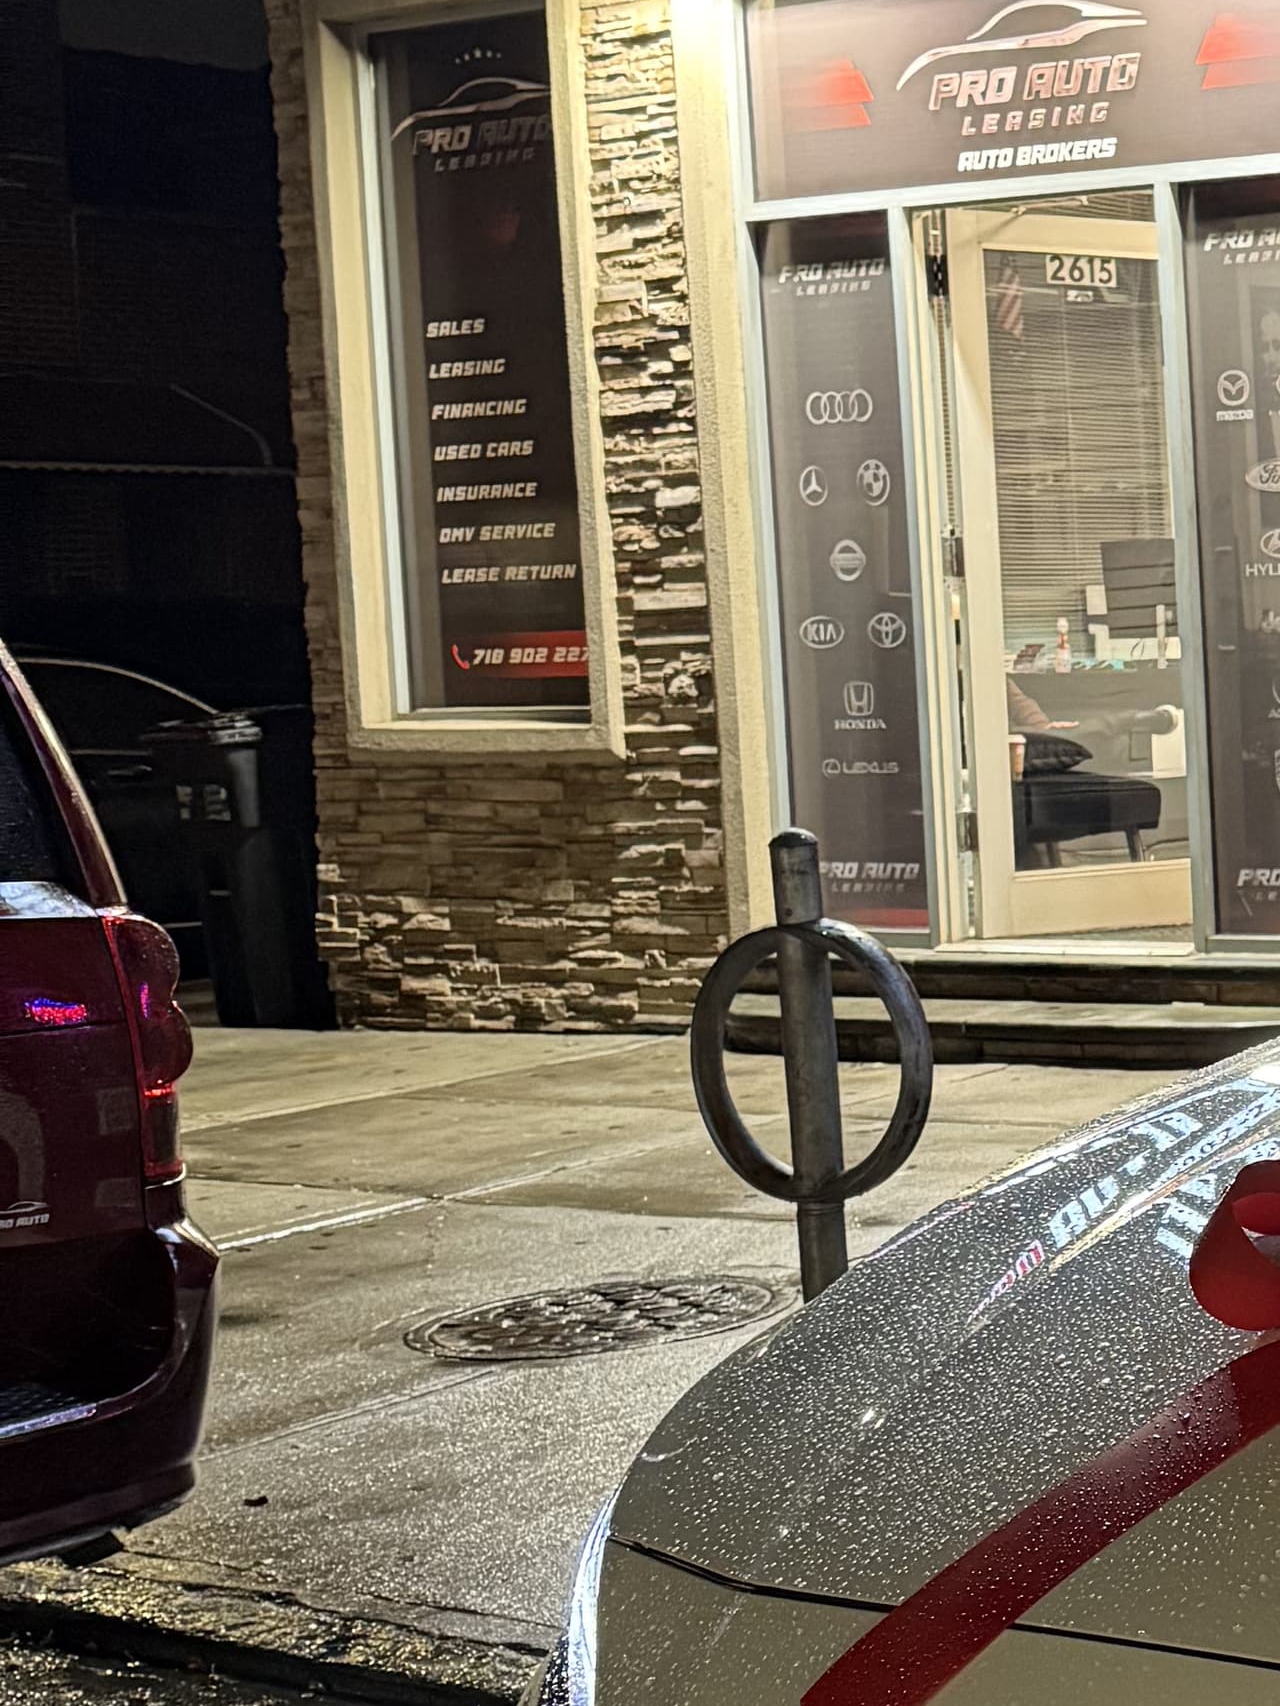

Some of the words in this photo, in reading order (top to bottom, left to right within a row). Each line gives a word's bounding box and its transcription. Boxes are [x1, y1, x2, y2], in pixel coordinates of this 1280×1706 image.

[929, 66, 1014, 110] PRO
[1022, 53, 1141, 101] AUTO
[961, 103, 1109, 136] LEASING
[412, 122, 472, 156] PRO
[476, 114, 552, 149] AUTO
[434, 146, 535, 173] LEASING
[957, 145, 1014, 171] AUTO
[1016, 137, 1117, 166] BROKERS
[1204, 231, 1254, 251] PRO
[778, 265, 822, 283] PRO
[826, 258, 885, 279] AUTO
[1049, 255, 1112, 284] 2615
[426, 319, 485, 338] SALES
[429, 359, 505, 379] LEASING
[431, 399, 527, 421] FINANCING
[434, 443, 481, 461] USED
[485, 440, 534, 458] CARS
[436, 483, 537, 502] INSURANCE
[439, 526, 475, 544] DMV
[480, 523, 556, 541] SERVICE
[441, 567, 499, 584] LEASE
[504, 564, 576, 581] RETURN
[807, 623, 836, 641] KIA
[472, 649, 504, 665] 718
[509, 648, 546, 664] 902
[834, 719, 886, 730] HONDA
[861, 862, 919, 879] AUTO
[15, 1213, 50, 1227] AUTO
